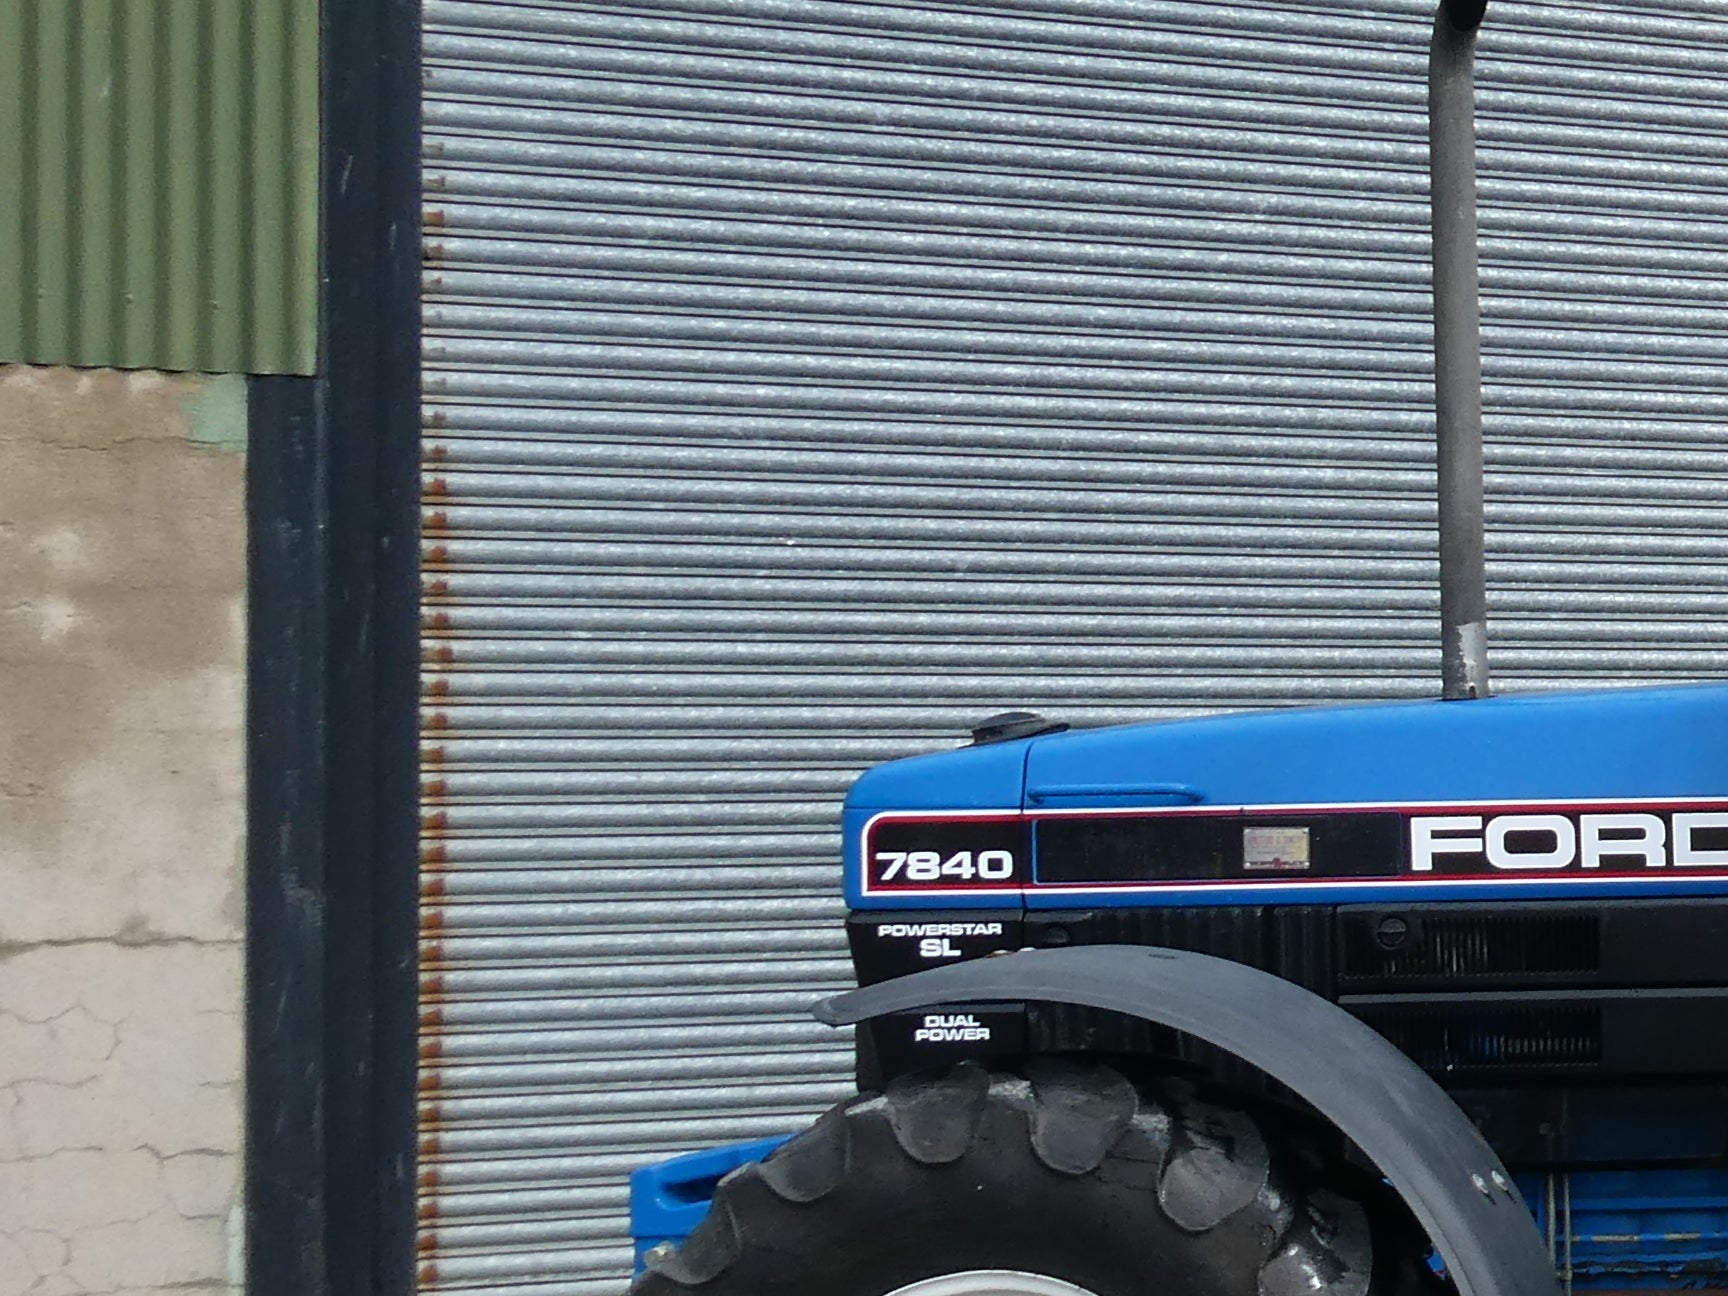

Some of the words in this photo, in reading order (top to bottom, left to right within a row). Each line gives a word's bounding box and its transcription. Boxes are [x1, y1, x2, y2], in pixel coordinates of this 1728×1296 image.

[875, 850, 1013, 881] 7840
[877, 923, 1003, 937] POWERSTAR
[919, 938, 962, 957] SL
[924, 1015, 981, 1027] DUAL
[914, 1028, 991, 1042] POWER
